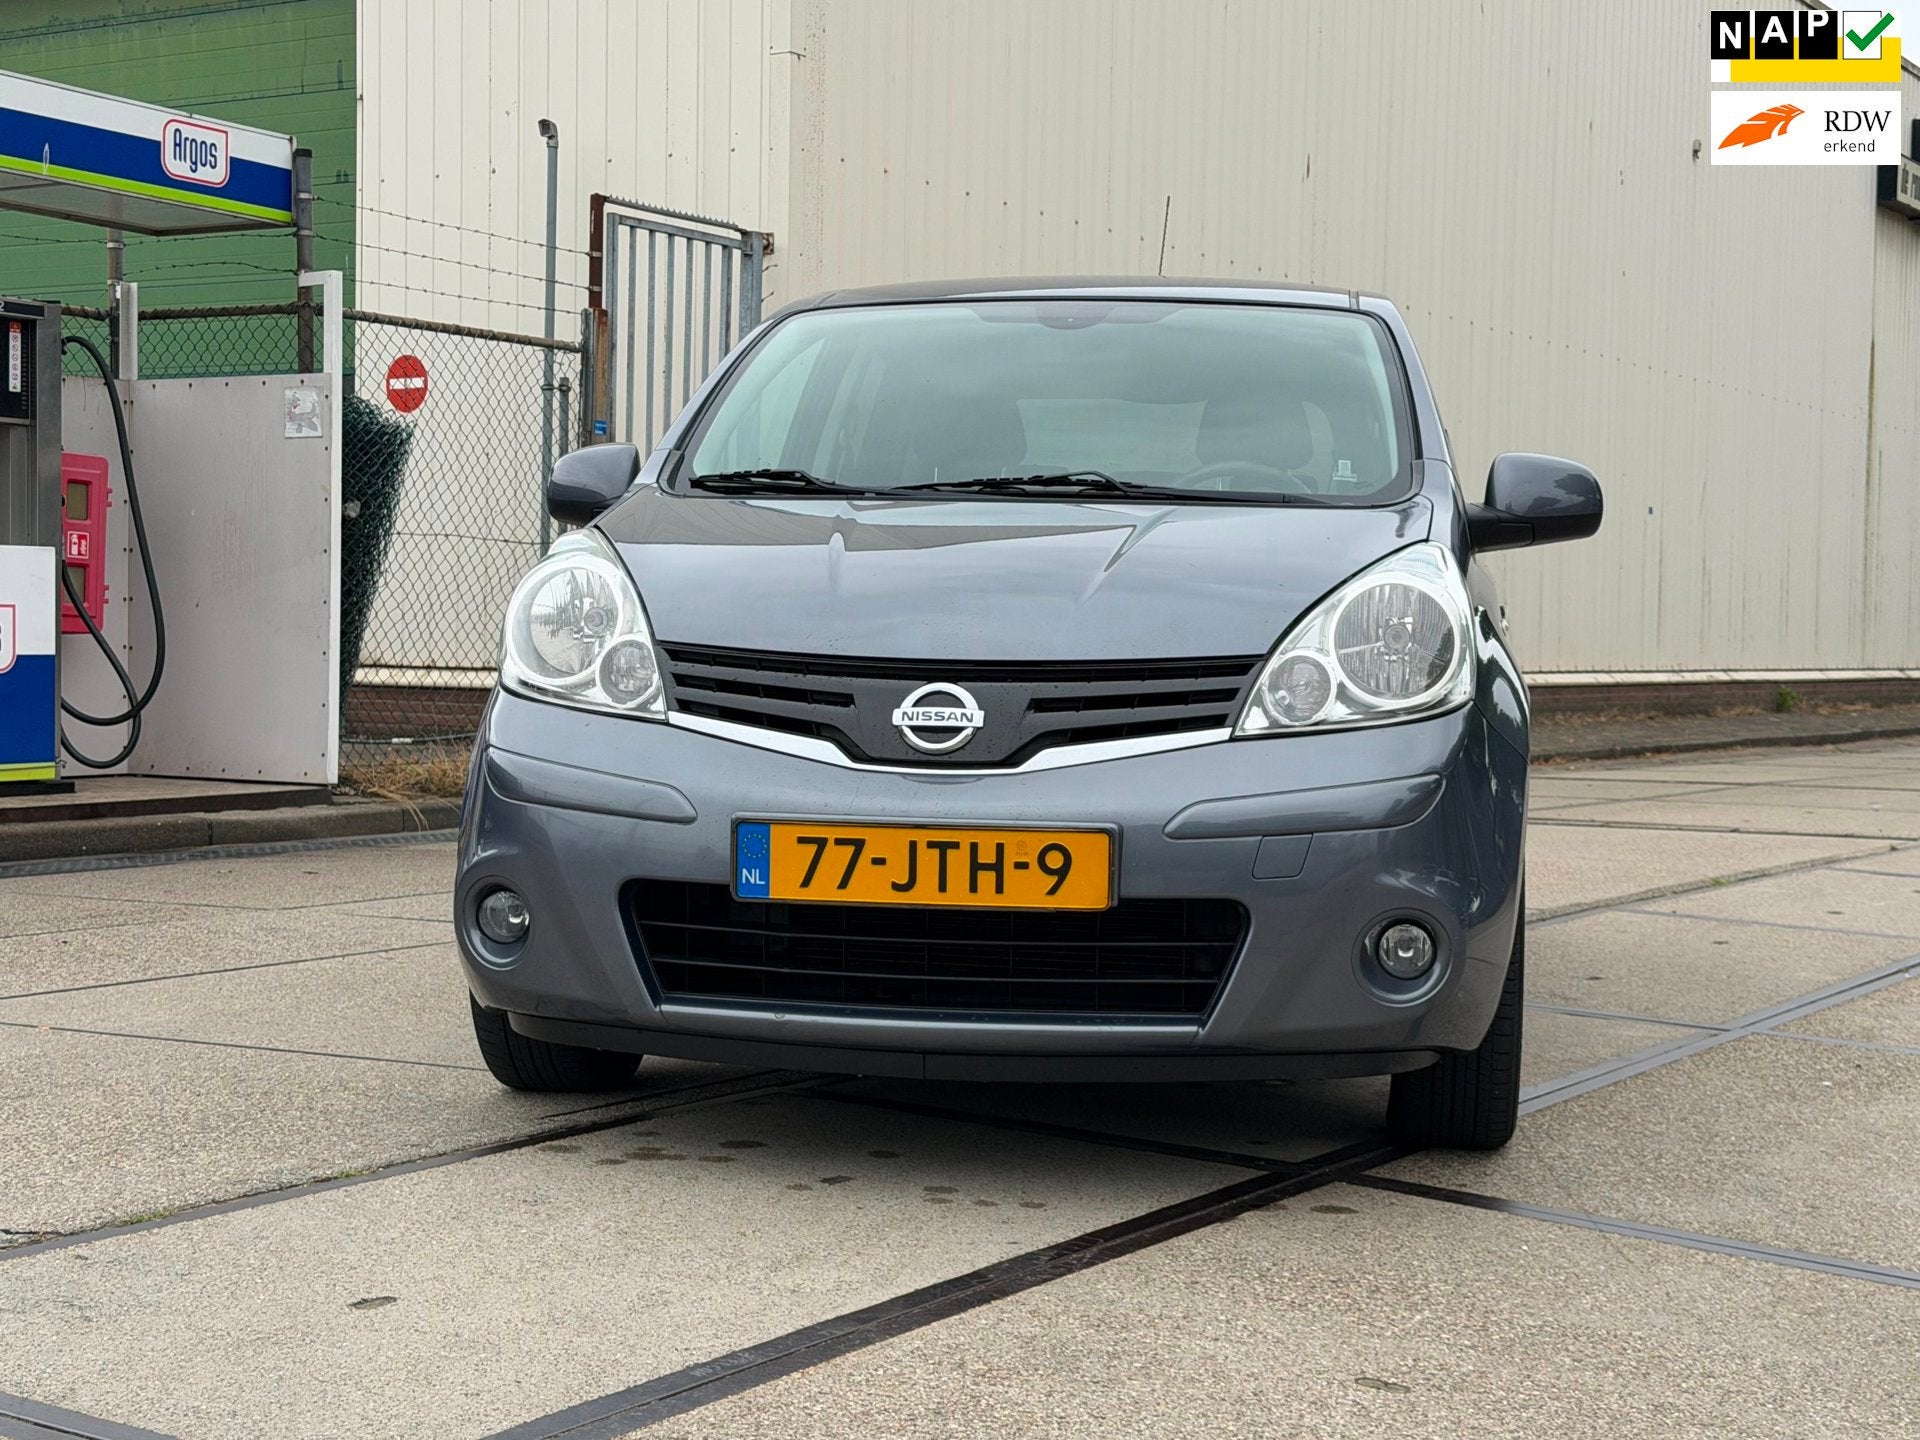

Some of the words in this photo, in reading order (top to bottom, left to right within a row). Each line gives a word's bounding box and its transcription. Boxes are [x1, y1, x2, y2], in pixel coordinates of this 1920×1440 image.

[173, 128, 218, 173] Argos
[901, 711, 974, 723] NISSAN
[742, 868, 766, 885] NL
[796, 836, 1073, 896] 77-JTH-9
